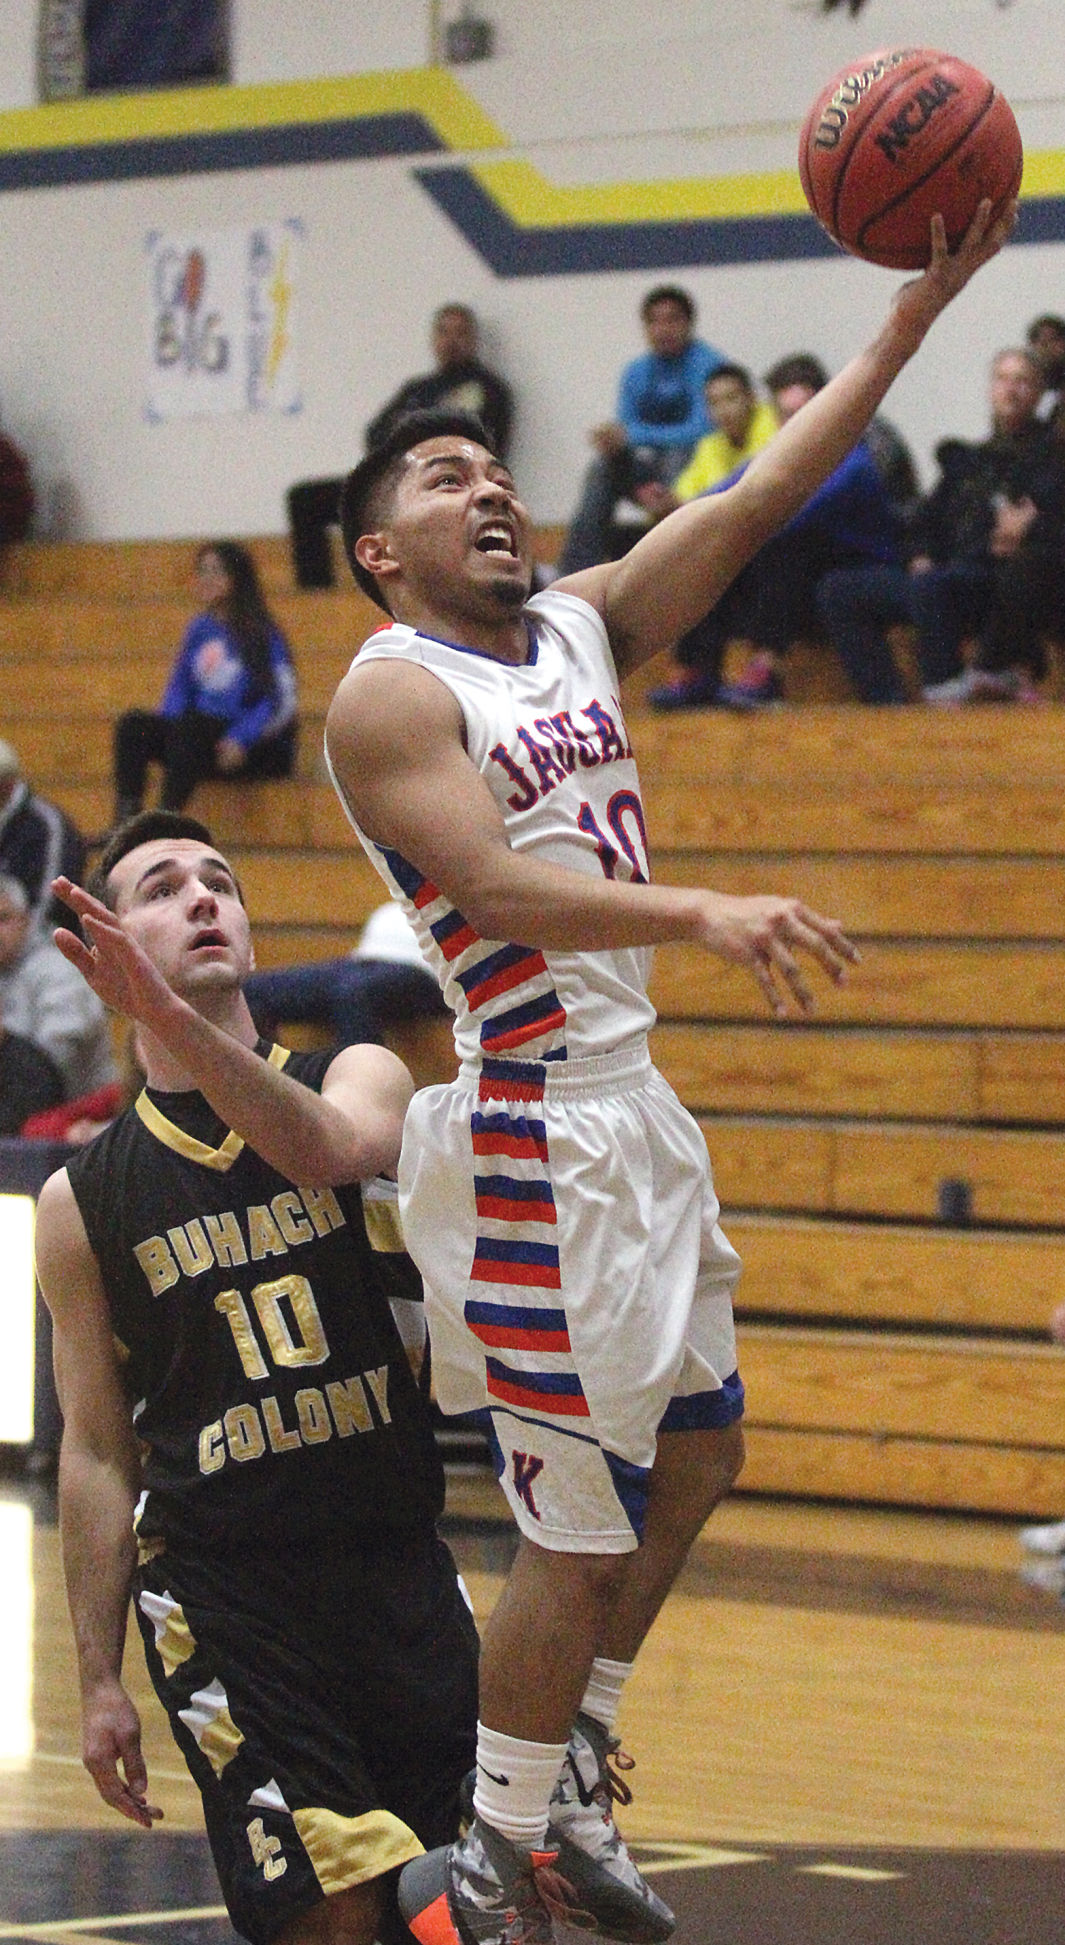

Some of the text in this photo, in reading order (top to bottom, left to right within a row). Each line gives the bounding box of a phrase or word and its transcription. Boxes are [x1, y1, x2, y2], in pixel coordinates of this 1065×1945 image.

[874, 73, 960, 164] NCAA
[488, 695, 634, 812] JAGUA
[576, 789, 651, 885] 10
[132, 1177, 347, 1298] BUHACH
[213, 1274, 330, 1380] 10
[198, 1364, 392, 1475] COLONY
[512, 1449, 544, 1523] K
